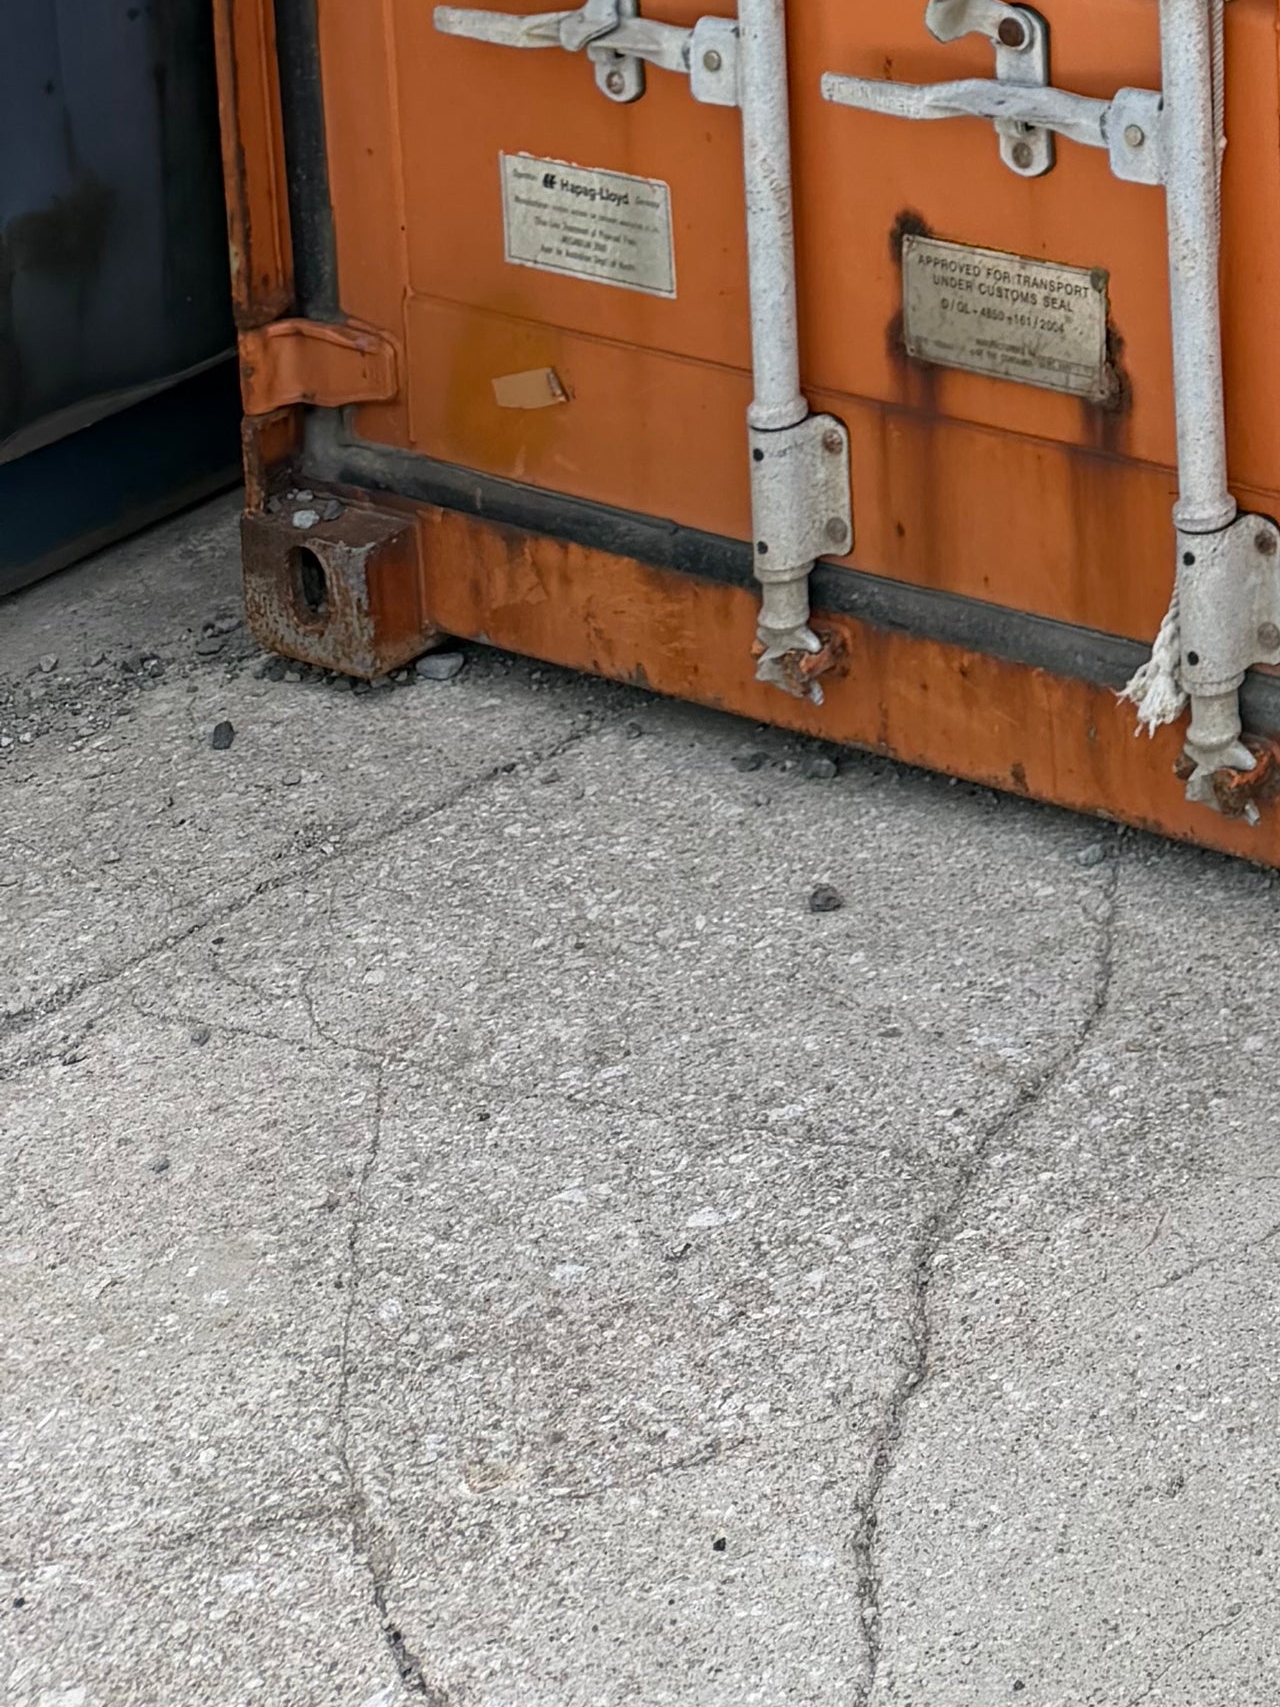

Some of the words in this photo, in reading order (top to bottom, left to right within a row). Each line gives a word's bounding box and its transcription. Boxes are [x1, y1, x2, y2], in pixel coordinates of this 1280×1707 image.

[917, 254, 981, 278] APPROVED
[986, 267, 1011, 285] FOR
[1016, 273, 1089, 298] TRANSPORT
[932, 274, 973, 292] UNDER
[978, 282, 1038, 306] CUSTOMS
[1043, 295, 1074, 313] SEAL
